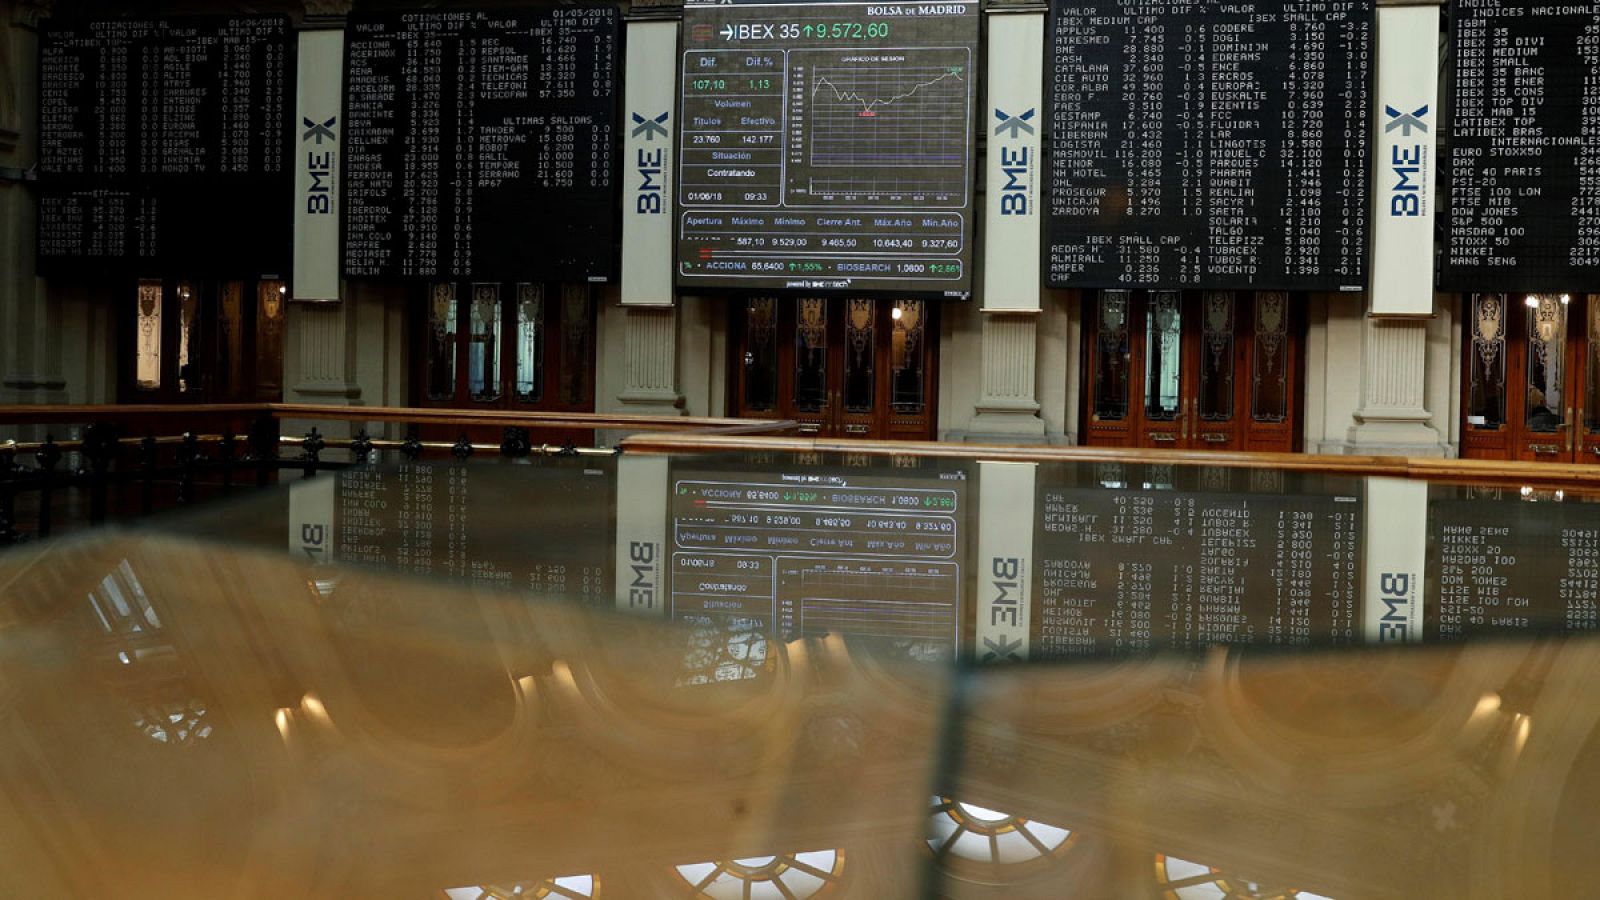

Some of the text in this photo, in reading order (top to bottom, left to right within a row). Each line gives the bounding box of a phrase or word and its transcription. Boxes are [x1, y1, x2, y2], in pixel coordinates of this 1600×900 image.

[868, 6, 903, 16] BOLSA
[918, 5, 966, 15] MADRID
[1063, 7, 1097, 16] VALOR
[1124, 6, 1165, 15] ULTIMO
[1172, 6, 1192, 14] DIF
[1473, 8, 1524, 16] INDICES
[1057, 16, 1158, 26] IBEX MEDIUM CAP
[1458, 19, 1486, 27] IGBM
[734, 23, 889, 40] IBEX 35 9.572,60
[1056, 25, 1206, 35] APPLUS 11.400 0.6
[1457, 28, 1509, 37] IBEX 35
[1457, 37, 1544, 47] IBEX 35 DIVI
[1457, 48, 1538, 57] IBEX MEDIUM
[700, 57, 774, 67] Dif. Dif.%
[1212, 62, 1367, 71] ENCE 6.860 1.8
[1457, 58, 1529, 67] IBEX SMALL
[1055, 64, 1109, 73] CATALANA
[1123, 64, 1164, 72] 37.600
[1456, 67, 1544, 77] IBEX 35 BANC
[481, 81, 575, 90] TELEFONI 7.611
[1456, 77, 1544, 87] IBEX 35 ENER
[1456, 87, 1544, 97] IBEX 35 CONS
[714, 100, 752, 108] Volumen
[1456, 97, 1544, 107] IBEX TOP DIV
[1455, 107, 1536, 117] IBEX MAB 15
[503, 116, 544, 125] ULTIMAS
[741, 117, 775, 126] Efectivo
[1454, 117, 1536, 127] LATIBEX TOP
[1513, 128, 1543, 136] BRAS
[712, 151, 752, 160] Situación
[1453, 148, 1542, 156] EURO STOXX50
[1453, 158, 1474, 166] DAX
[478, 170, 520, 178] SERRANO
[537, 170, 573, 178] 21.600
[707, 169, 756, 177] Contratando
[1452, 167, 1542, 176] CAC 40 PARIS
[308, 152, 329, 214] BME
[637, 148, 661, 214] BME
[1001, 147, 1028, 215] BME
[1391, 145, 1420, 216] BME
[1452, 178, 1497, 186] PSI-20
[688, 192, 768, 200] 01/06/18 09:33
[1451, 188, 1541, 196] FTSE 100 LON
[1451, 198, 1511, 206] FTSE MIB
[1451, 208, 1518, 216] DOW JONES
[686, 216, 722, 226] Apertura
[816, 218, 843, 226] Cierre
[1451, 217, 1503, 226] S&P 500
[1208, 226, 1244, 235] TALGO
[1285, 227, 1320, 236] 5.040
[1451, 227, 1525, 236] NASDAQ 100
[772, 238, 808, 247] 9.529,00
[1086, 236, 1181, 244] IBEX SMALL CAP
[1451, 237, 1510, 245] STOXX 50
[1451, 248, 1493, 256] NIKKEI
[1051, 255, 1200, 264] ALMIRALL 11.250 4.1
[1450, 257, 1480, 266] HANG
[1488, 257, 1517, 266] SENG
[706, 262, 747, 270] ACCIONA
[836, 263, 891, 272] BIOSEARCH
[1051, 264, 1201, 273] AMPER 0.236 2.5
